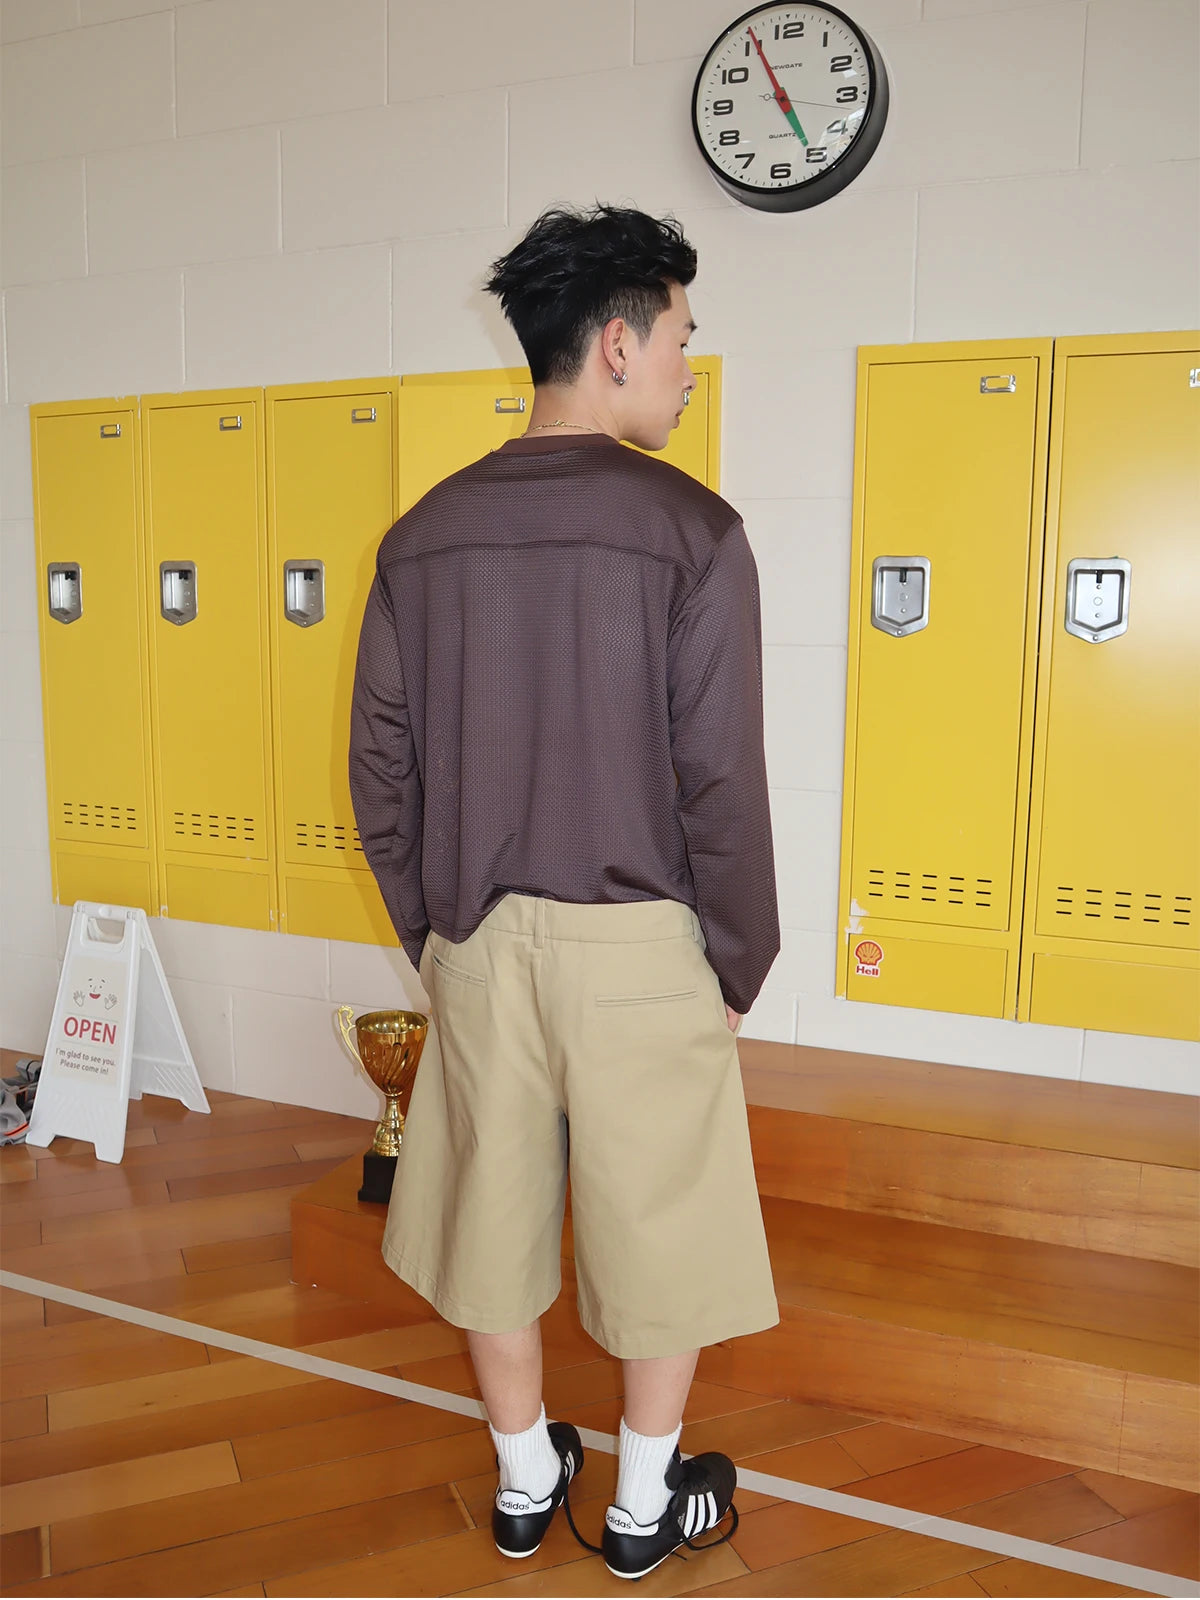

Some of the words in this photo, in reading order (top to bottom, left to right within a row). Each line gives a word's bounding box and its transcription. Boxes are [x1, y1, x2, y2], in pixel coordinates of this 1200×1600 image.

[774, 22, 804, 40] 12
[822, 31, 828, 47] 1
[830, 55, 852, 73] 2
[722, 67, 749, 85] 10
[836, 86, 858, 103] 3
[713, 99, 733, 116] 9
[826, 119, 848, 135] 4
[719, 130, 740, 146] 8
[735, 153, 755, 169] 7
[805, 146, 827, 163] 5
[770, 163, 791, 179] 6
[856, 965, 879, 976] Hell
[64, 1016, 117, 1045] OPEN
[56, 1048, 66, 1056] I'm
[66, 1050, 82, 1059] glad
[82, 1053, 90, 1061] to
[90, 1055, 101, 1063] see
[60, 1058, 81, 1069] Please
[81, 1064, 99, 1073] come
[500, 1500, 530, 1510] adidas
